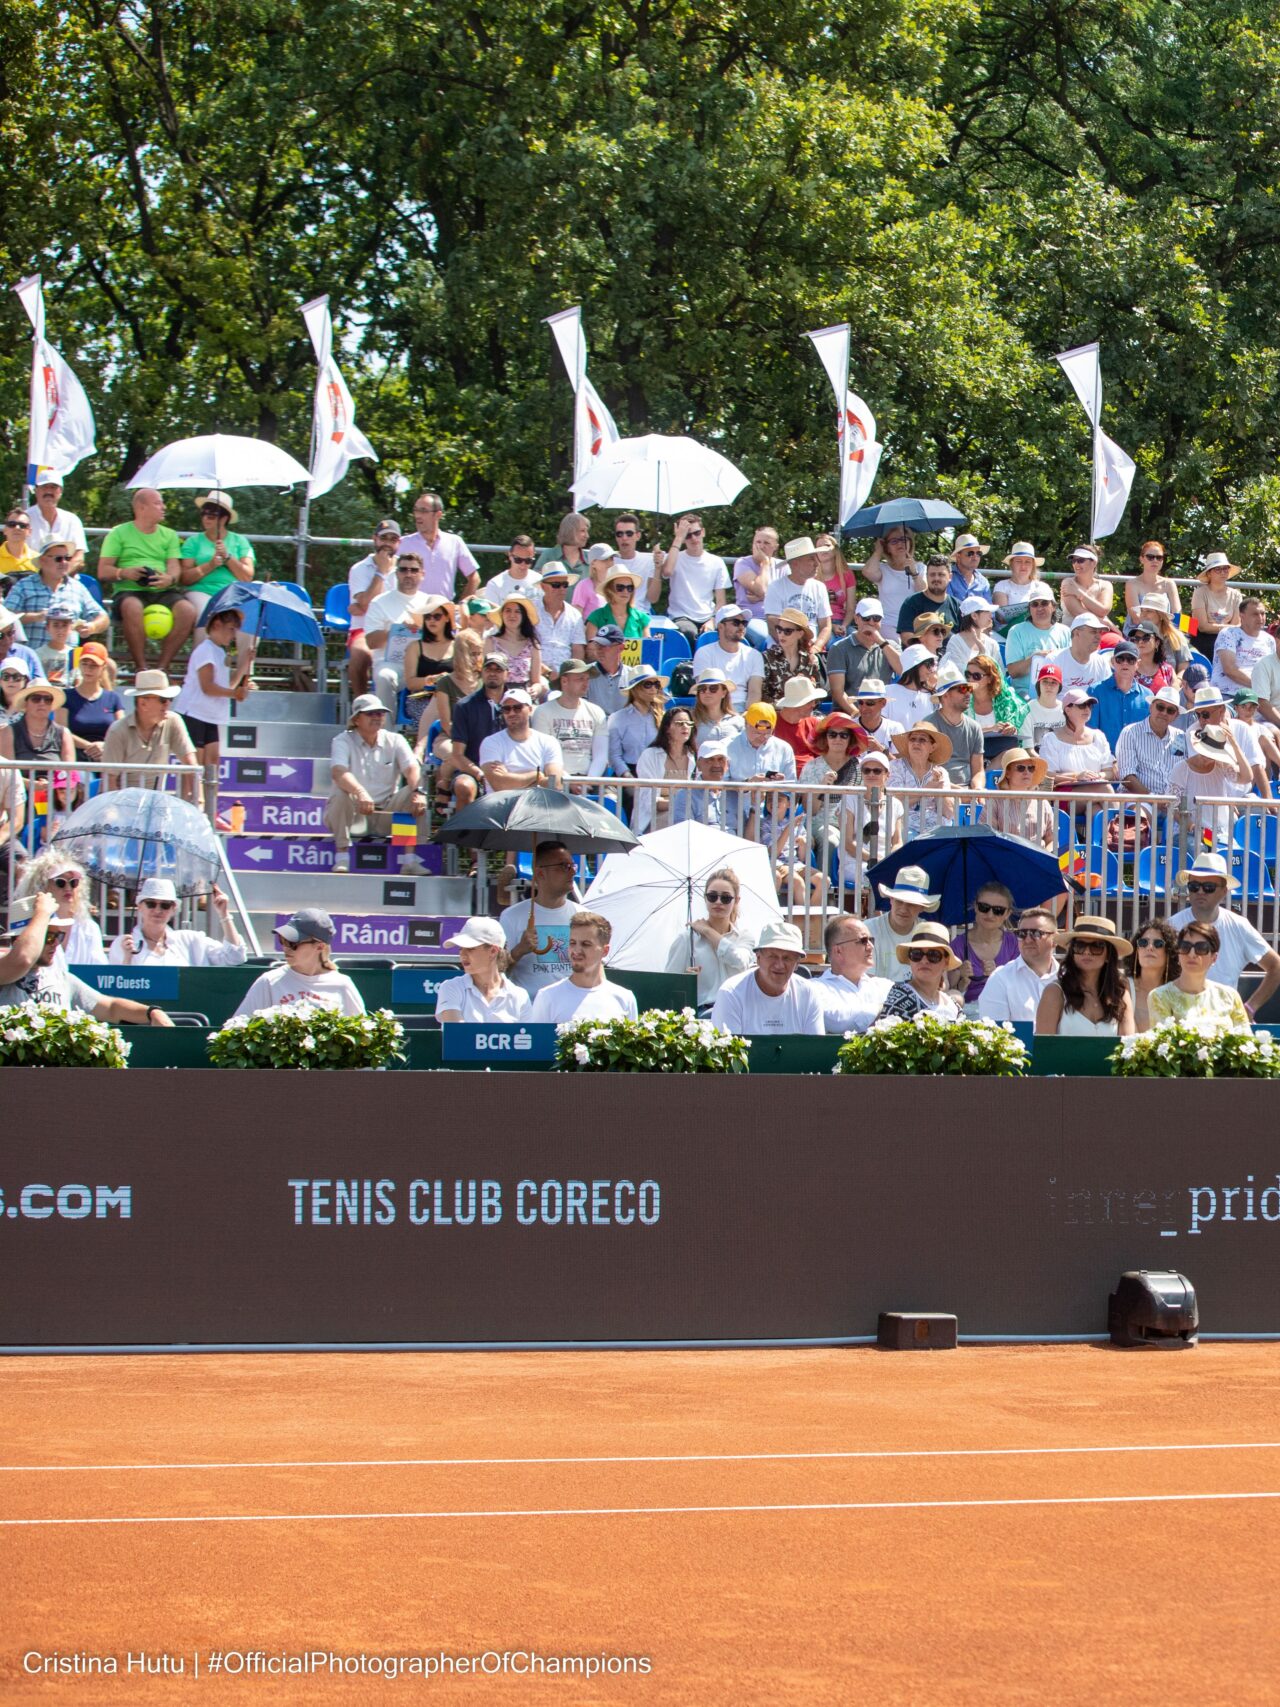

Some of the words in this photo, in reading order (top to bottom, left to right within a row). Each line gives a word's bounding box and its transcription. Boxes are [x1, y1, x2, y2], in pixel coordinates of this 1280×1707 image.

[262, 805, 322, 826] Rând
[288, 844, 336, 865] Rân
[341, 923, 405, 945] Rând
[97, 975, 115, 989] VIP
[116, 975, 151, 990] Guests
[475, 1033, 511, 1050] BCR
[288, 1179, 396, 1225] TENIS
[409, 1179, 502, 1225] CLUB
[516, 1179, 660, 1225] CORECO
